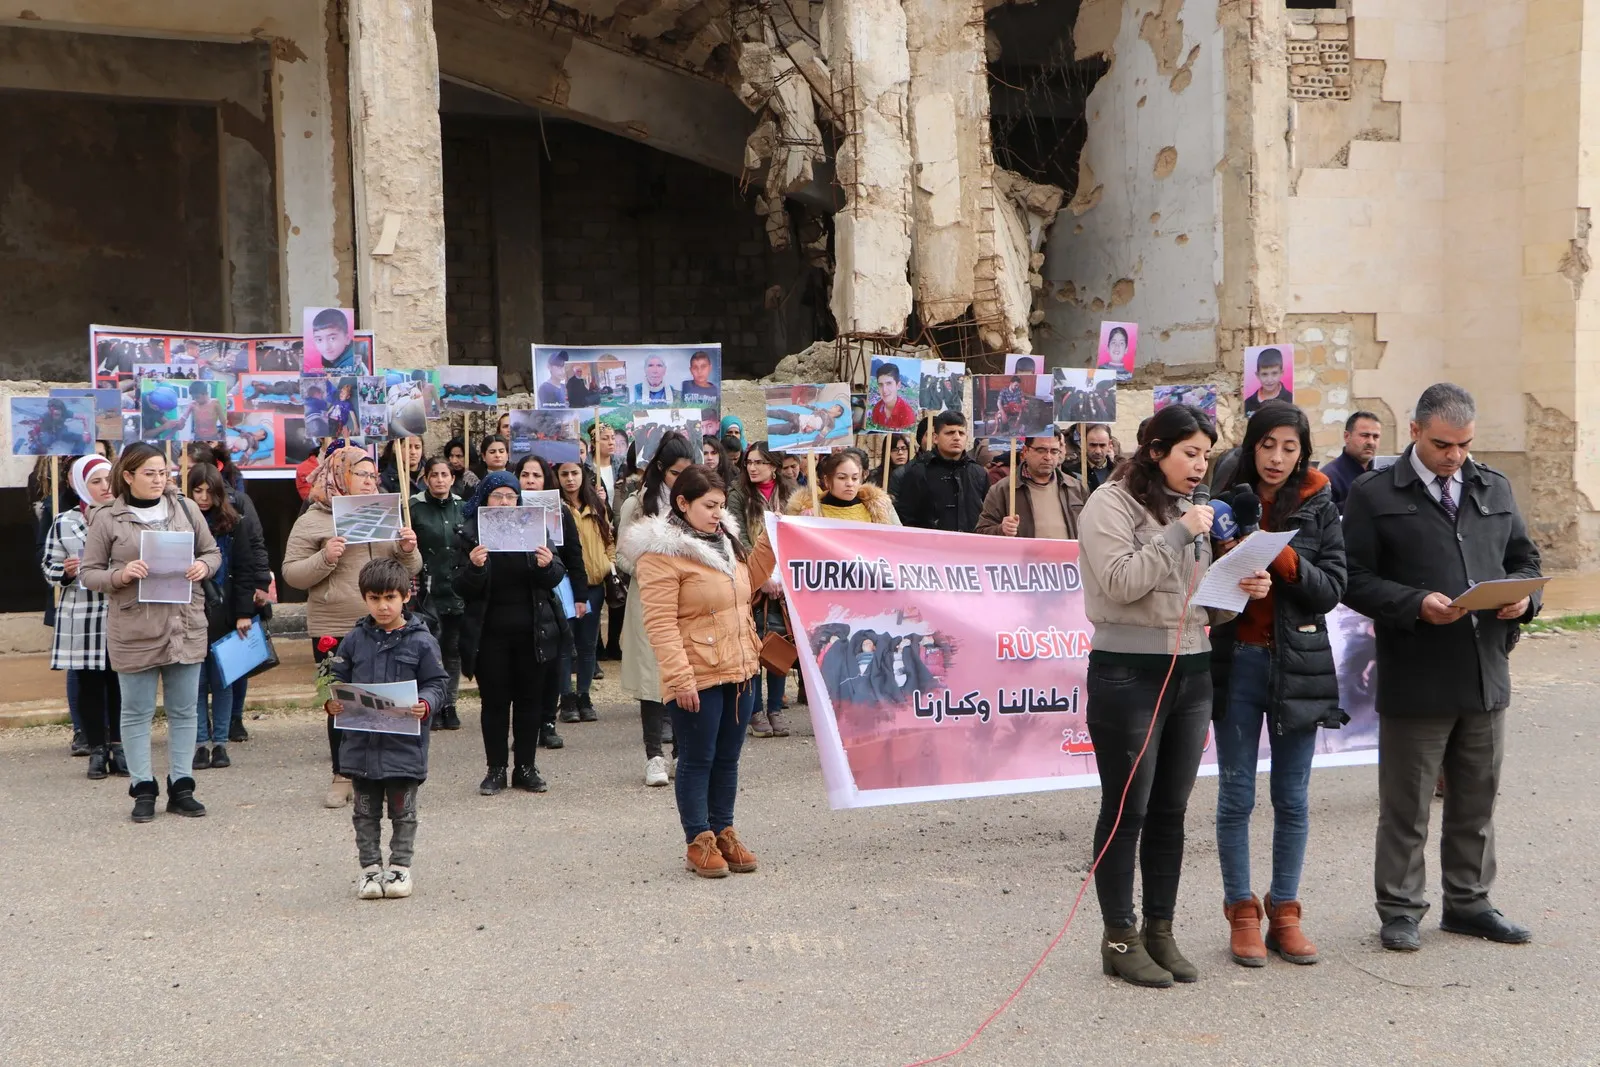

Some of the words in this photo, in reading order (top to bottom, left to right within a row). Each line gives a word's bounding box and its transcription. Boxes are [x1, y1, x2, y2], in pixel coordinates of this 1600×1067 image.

[1218, 513, 1235, 532] R
[898, 564, 944, 591] AXA
[944, 564, 982, 591] ME
[984, 562, 1061, 591] TALAN
[914, 690, 991, 723] وكبارنا
[999, 687, 1079, 714] أطفالنا
